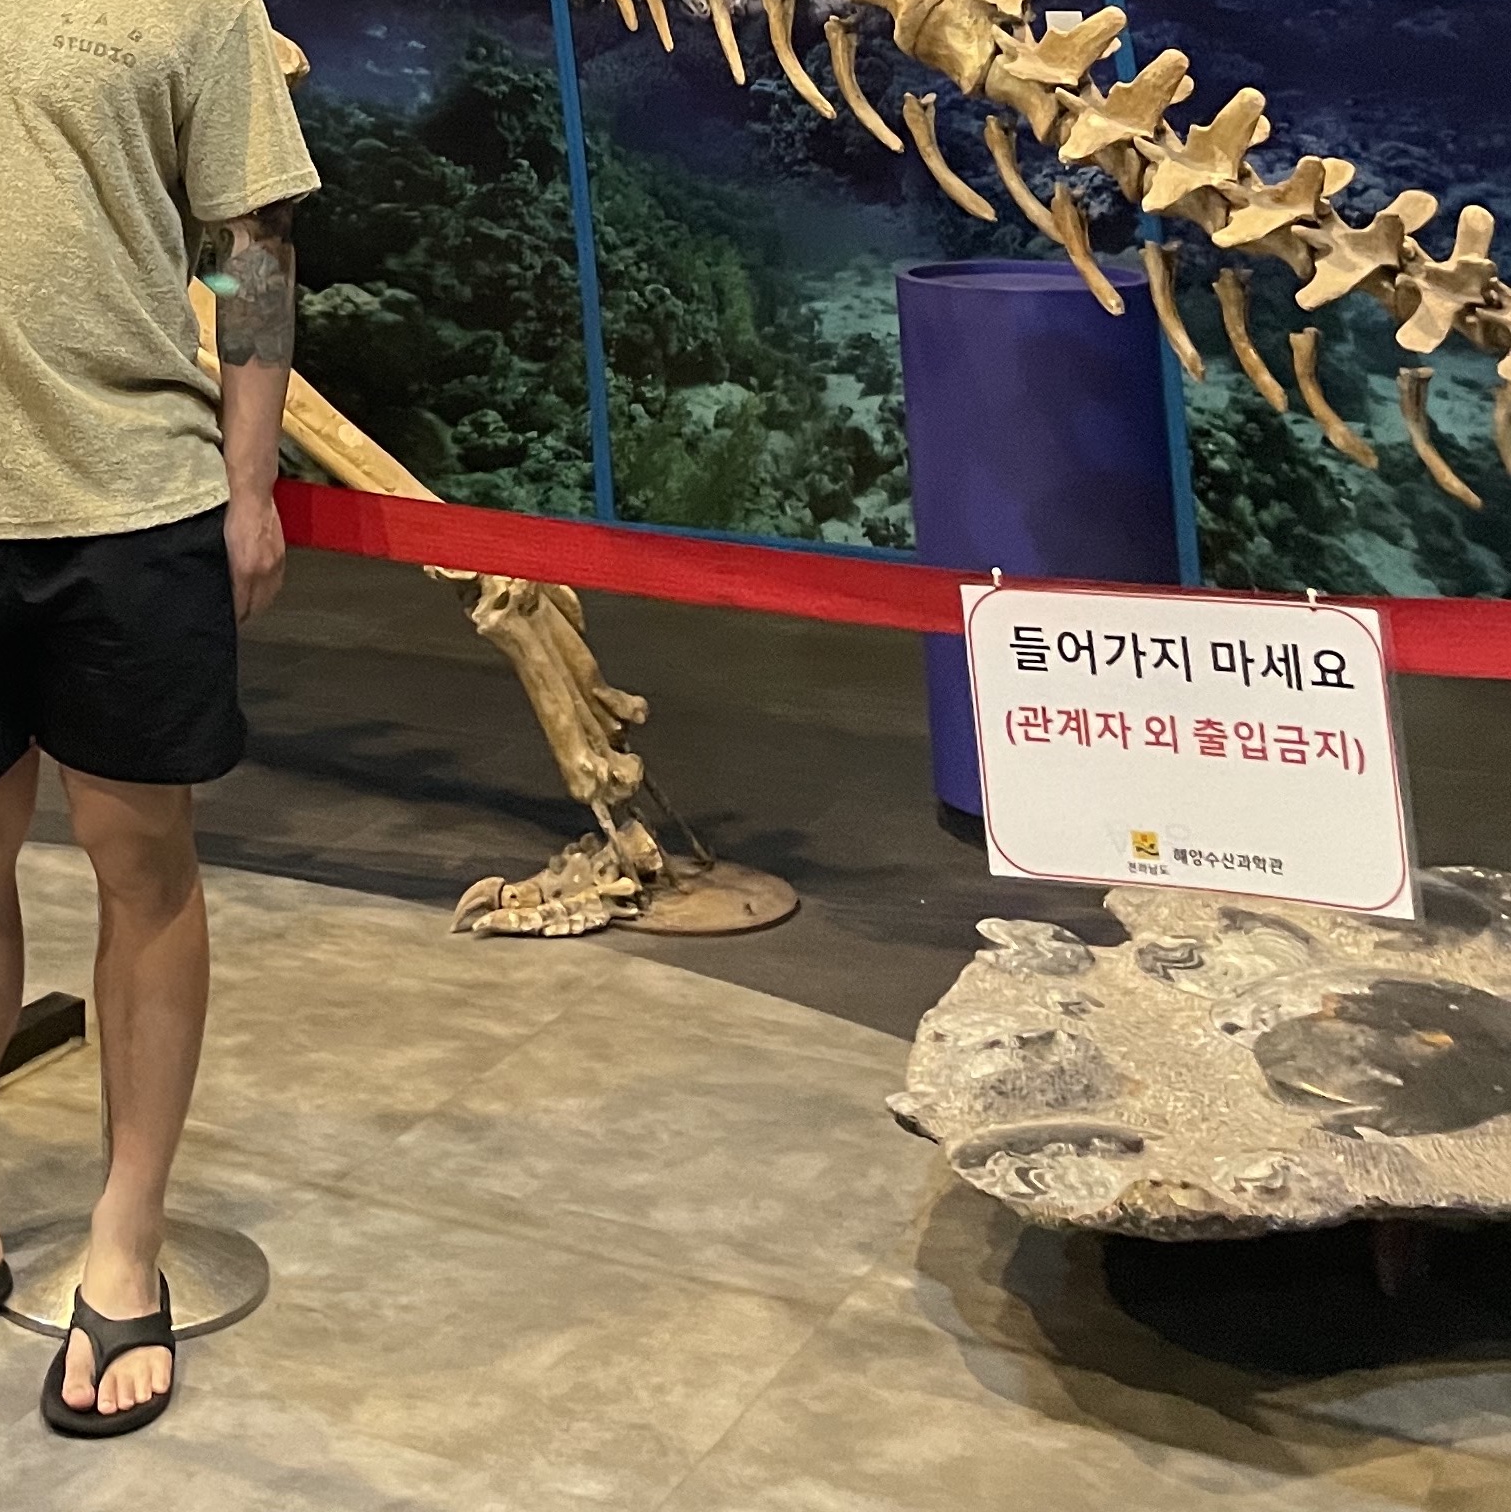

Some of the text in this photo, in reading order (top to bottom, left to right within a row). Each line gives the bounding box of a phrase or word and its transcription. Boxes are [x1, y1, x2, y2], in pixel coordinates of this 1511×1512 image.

[52, 35, 136, 68] STUDIO
[1009, 625, 1355, 691] 들어가지 마세요
[1005, 706, 1366, 775] (관계자 외 출입금지)
